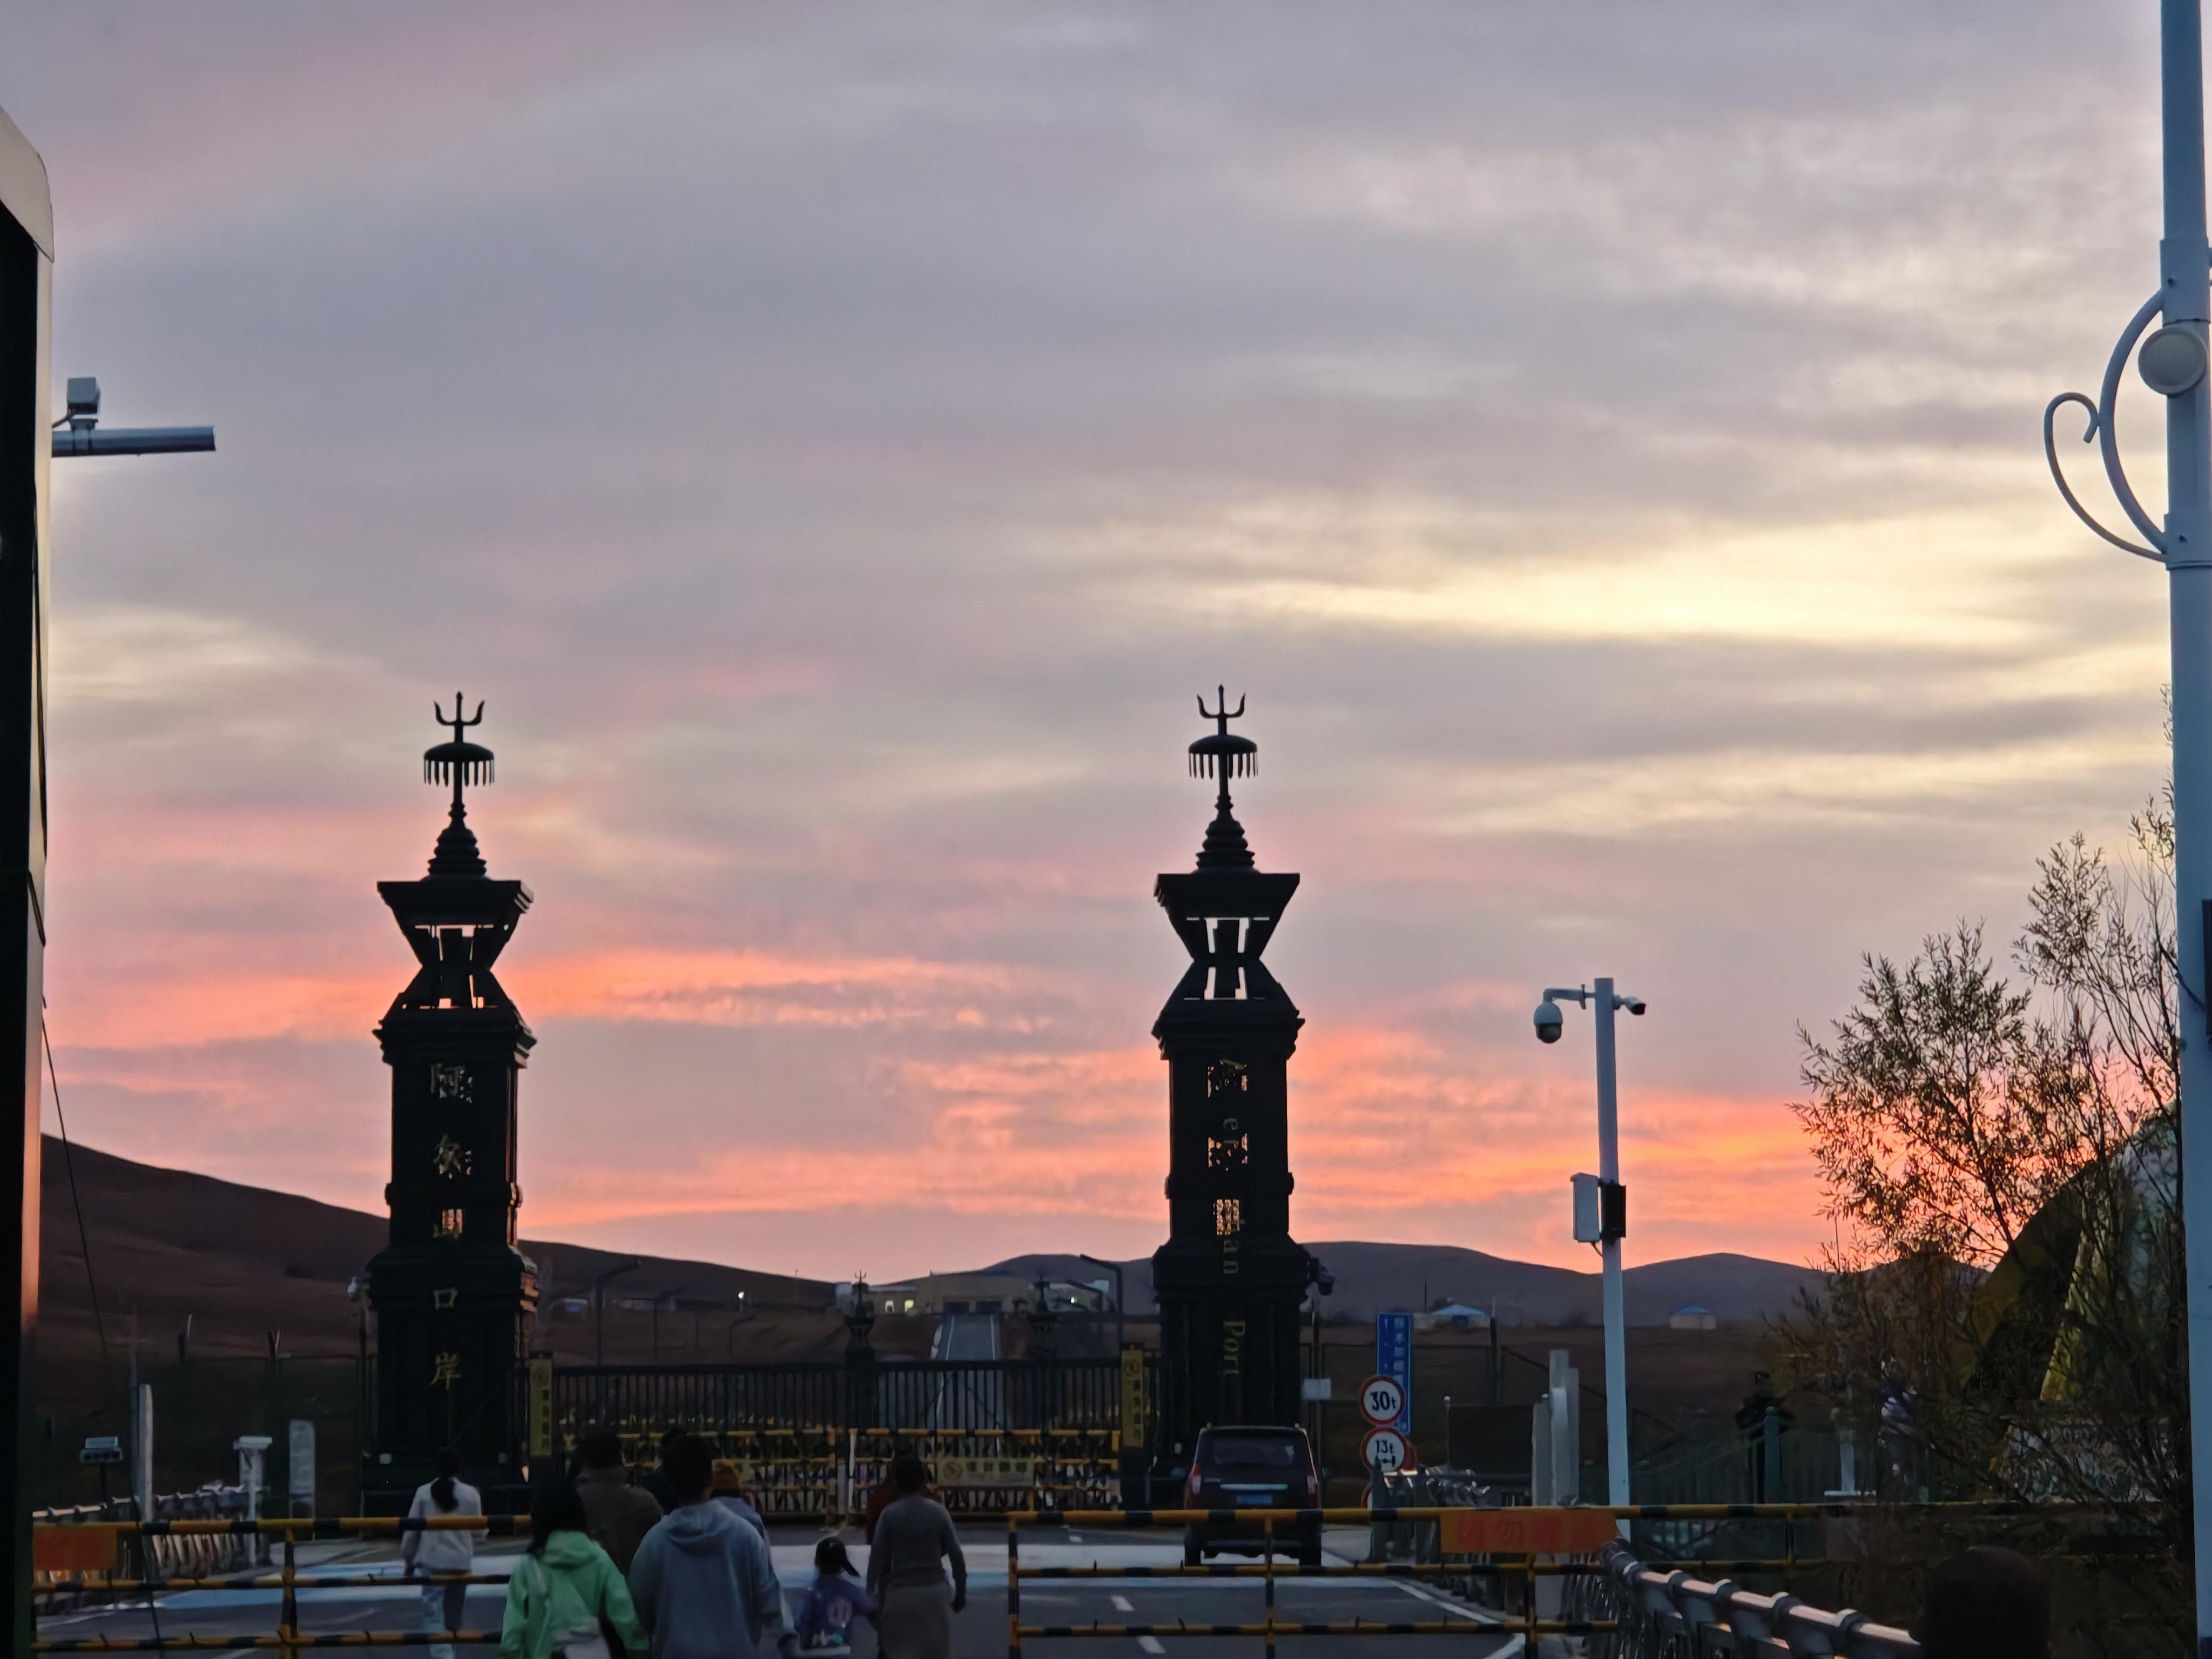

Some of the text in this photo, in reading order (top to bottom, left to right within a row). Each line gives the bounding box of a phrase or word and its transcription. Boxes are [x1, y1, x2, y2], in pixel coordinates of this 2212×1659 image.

[1223, 1320, 1246, 1375] Port
[1370, 1391, 1396, 1411] 30t
[1375, 1439, 1394, 1454] 13t
